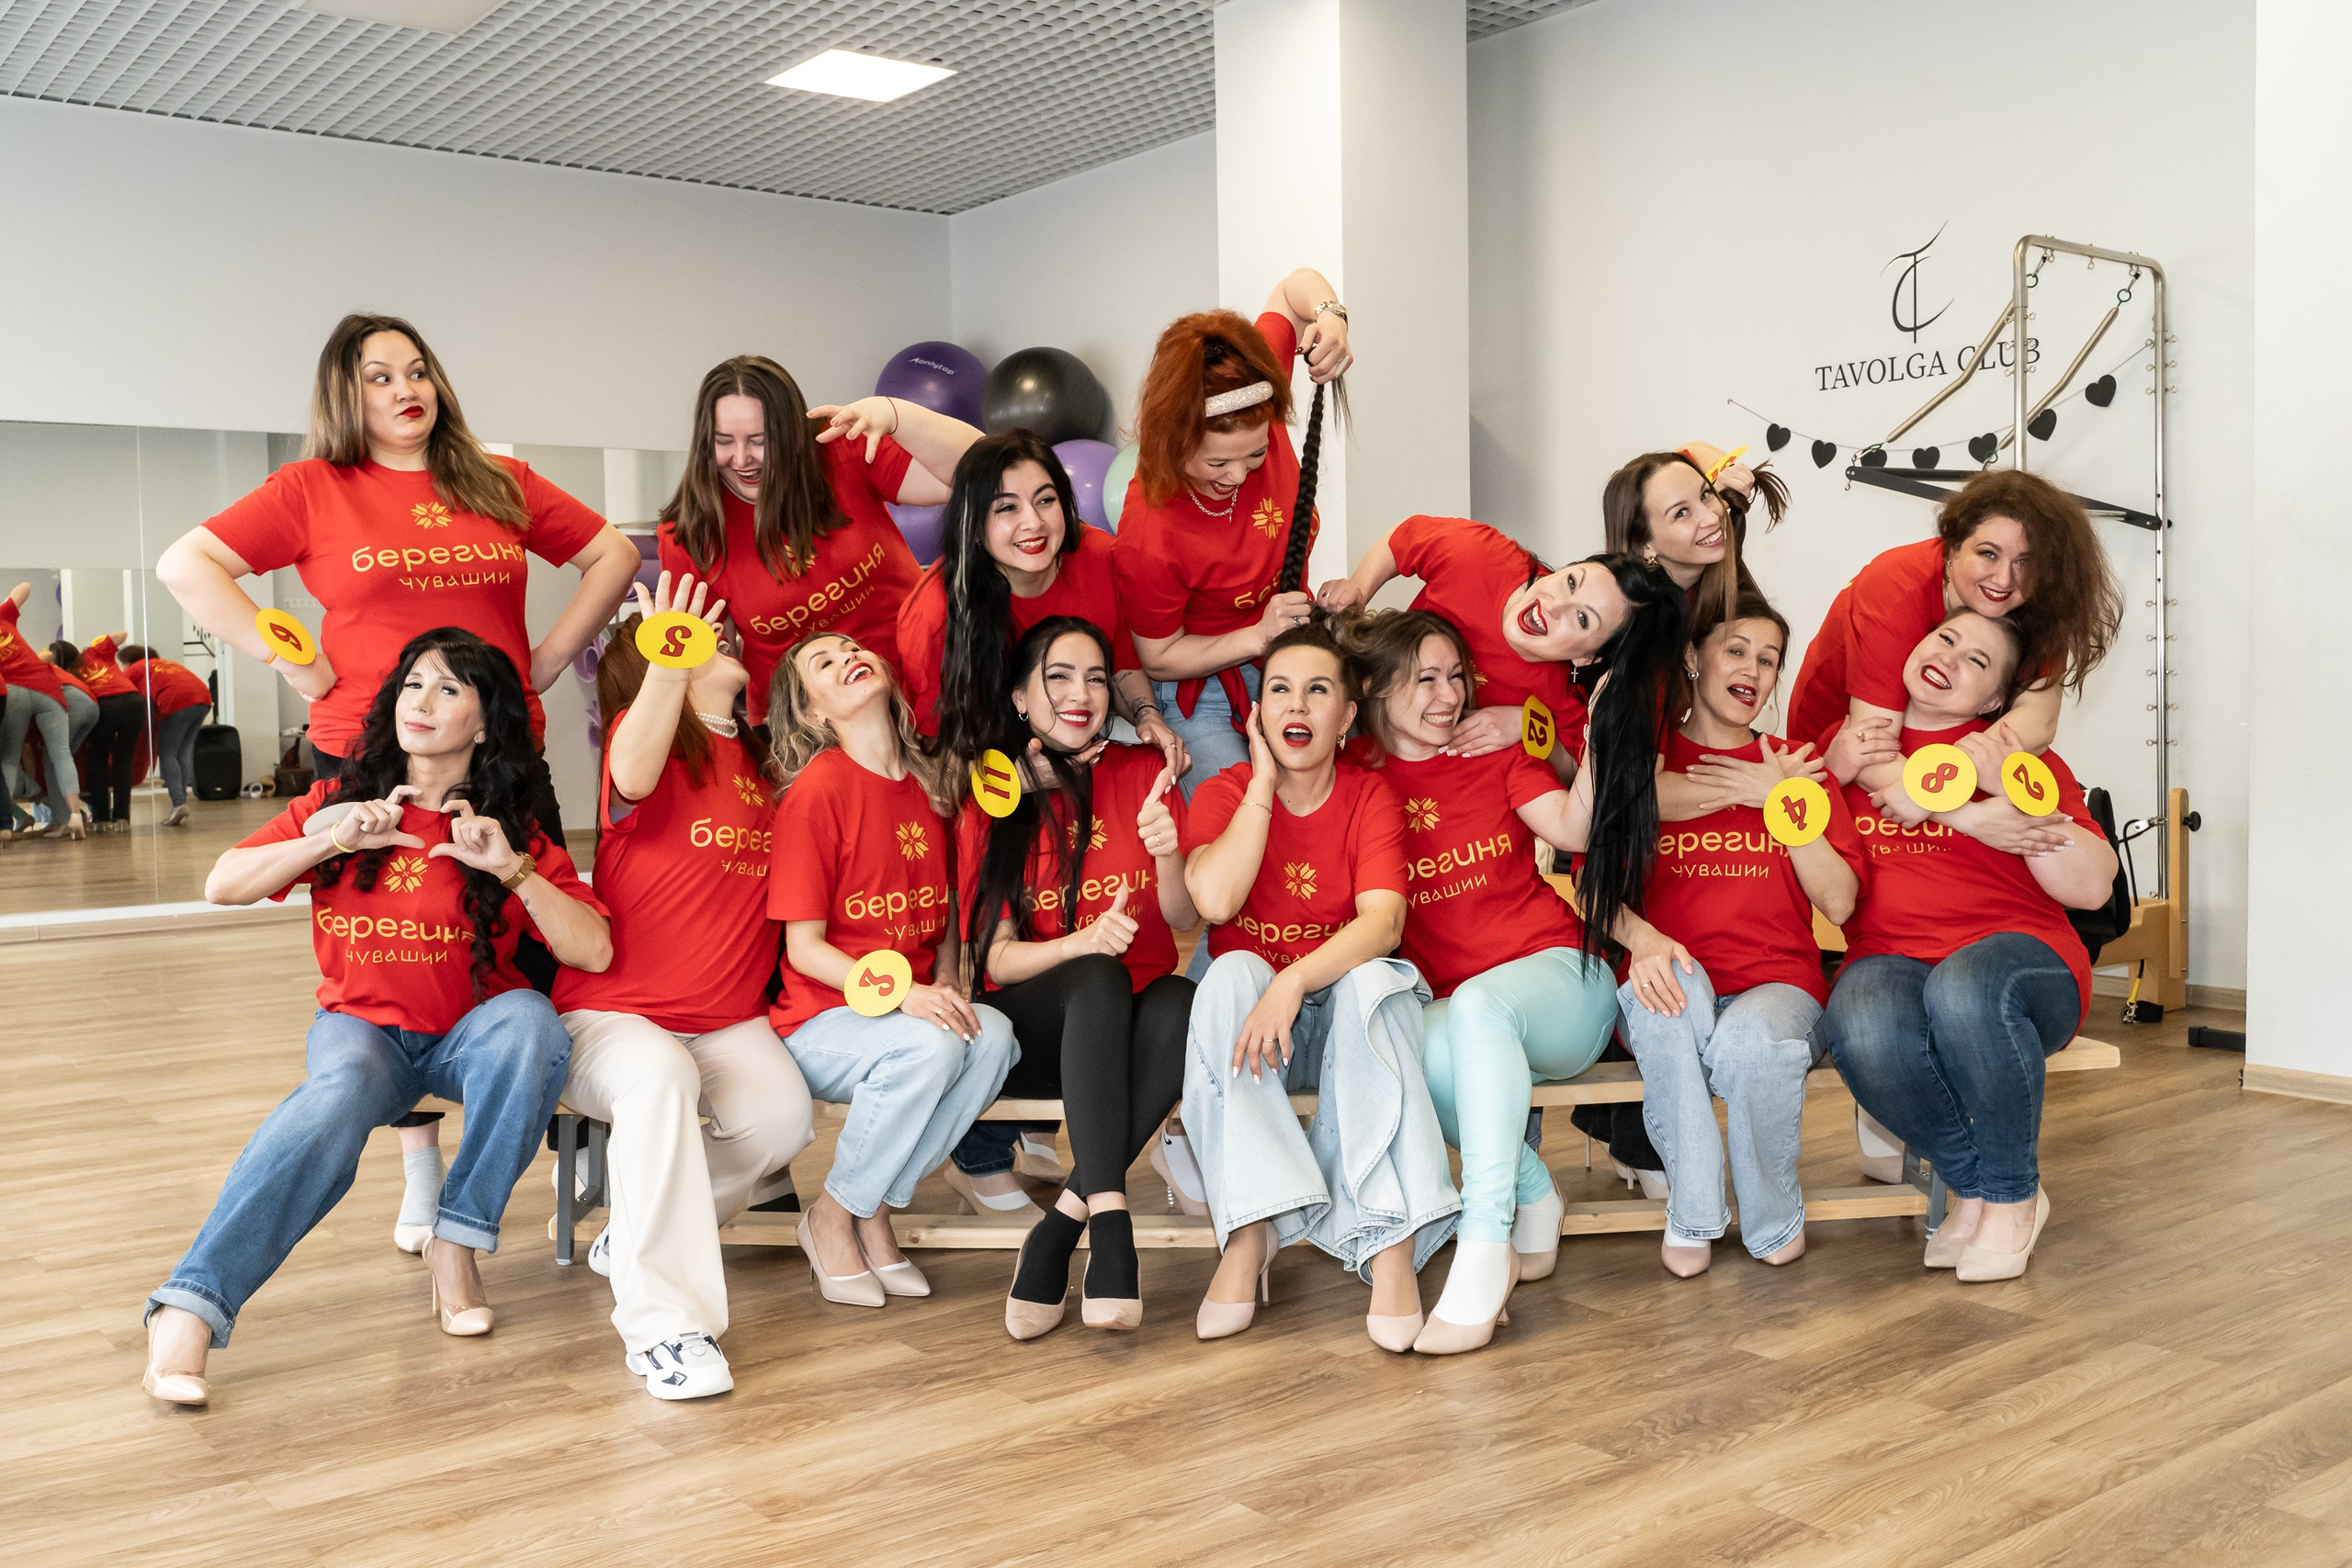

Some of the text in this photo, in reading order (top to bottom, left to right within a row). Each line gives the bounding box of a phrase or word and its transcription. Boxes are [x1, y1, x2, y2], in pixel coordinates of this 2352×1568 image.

[1815, 350, 1948, 391] TAVOLGA
[399, 571, 511, 592] чувашии
[759, 542, 886, 635] берегиня
[794, 584, 875, 637] увашии
[1527, 708, 1549, 748] 12
[1921, 762, 1959, 794] 8
[2012, 763, 2045, 802] 2
[1657, 830, 1790, 859] ерегин
[1670, 864, 1770, 879] чувашии
[345, 949, 447, 965] чувашии
